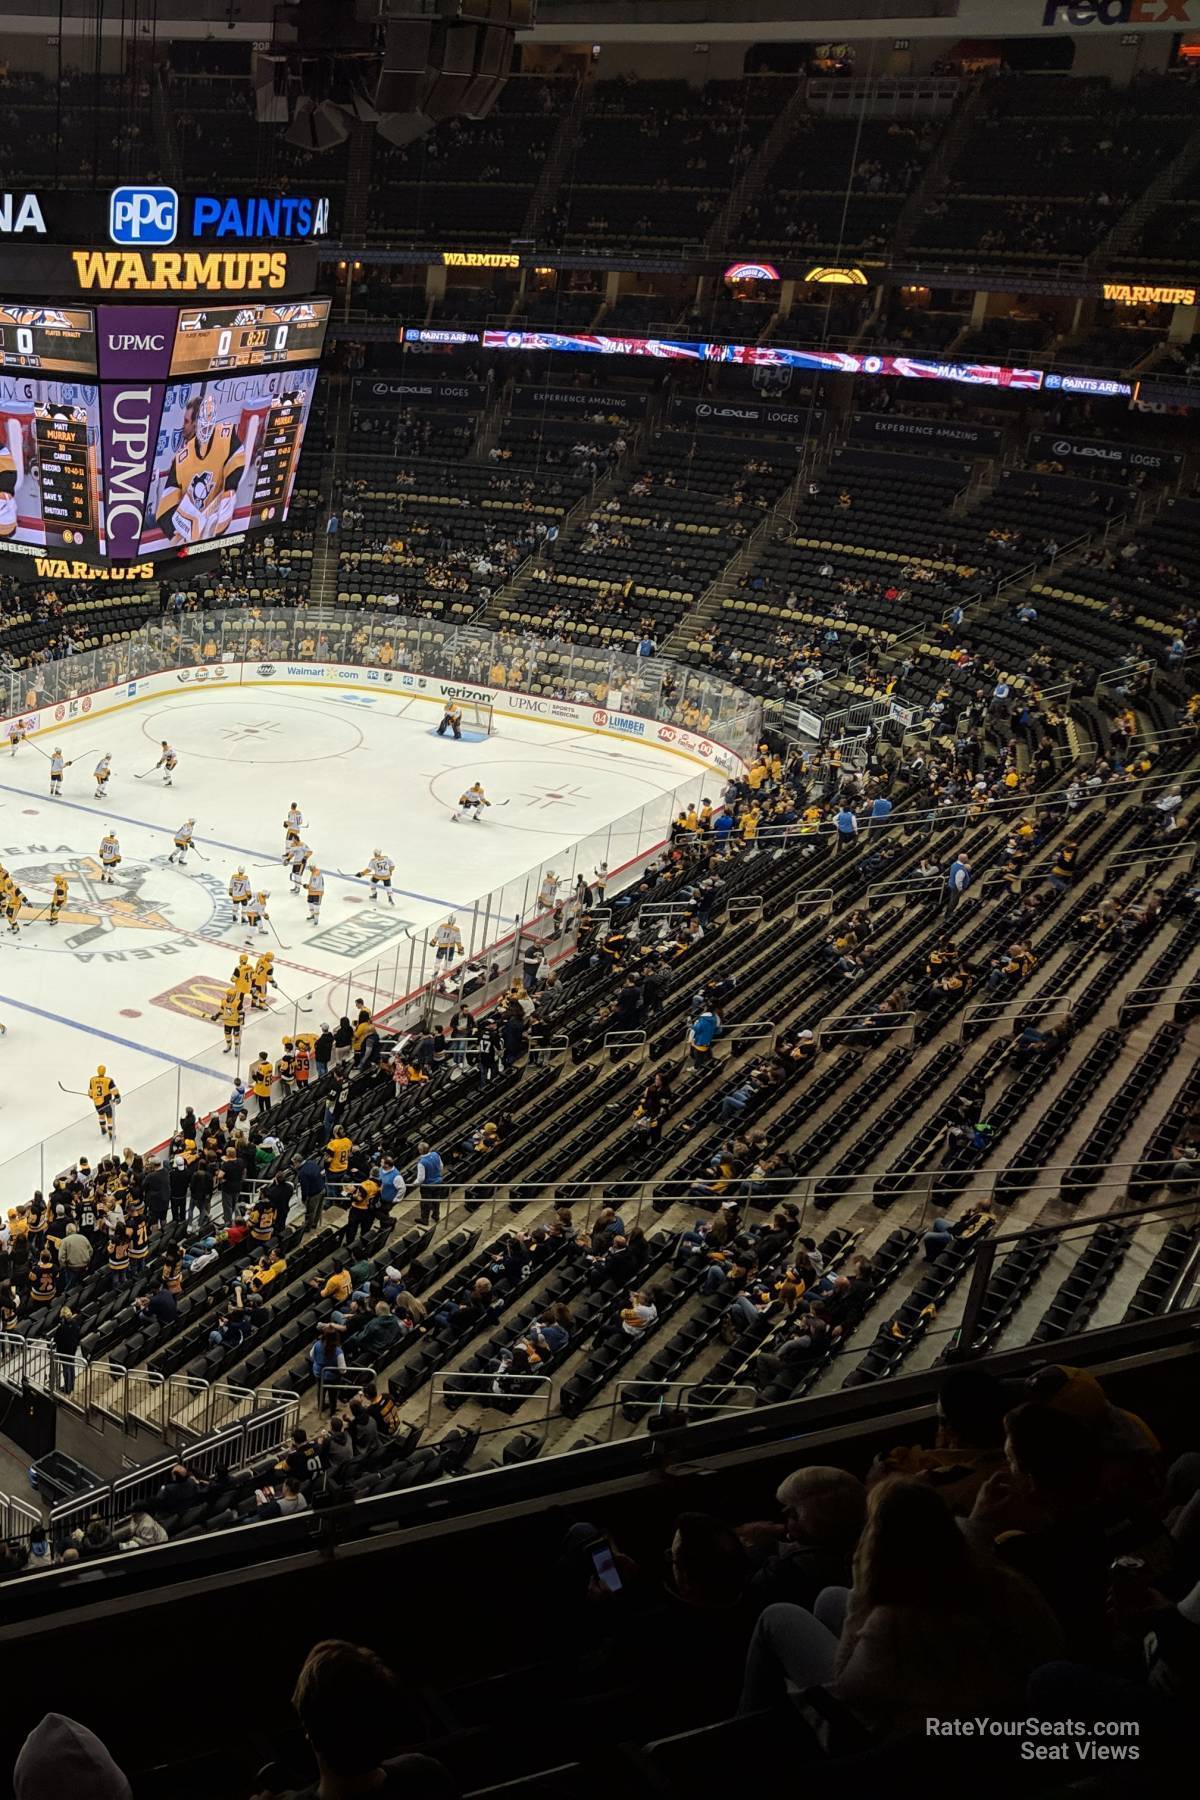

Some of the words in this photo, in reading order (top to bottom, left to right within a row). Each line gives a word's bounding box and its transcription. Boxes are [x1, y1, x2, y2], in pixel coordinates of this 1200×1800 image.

[114, 194, 174, 238] PPG
[192, 198, 312, 237] PAINTS
[442, 253, 520, 268] WARMUPS
[72, 251, 286, 290] WARMUPS
[1103, 284, 1196, 305] WARMUPS
[16, 328, 33, 353] 0
[108, 335, 165, 351] UPMC
[218, 331, 232, 355] 0
[275, 326, 288, 350] 0
[420, 331, 449, 341] PAINTS
[450, 333, 479, 342] ARENA
[390, 386, 432, 395] LEXUS
[440, 387, 469, 398] LOGES
[1062, 378, 1097, 391] PAINTS
[1099, 382, 1131, 394] ARENA
[534, 393, 585, 404] EXPERIENCE
[588, 396, 627, 408] AMAZING
[714, 409, 759, 418] LEXUS
[767, 411, 799, 424] LOGES
[46, 430, 76, 442] MURRAY
[875, 422, 933, 436] EXPERIENCE
[936, 427, 978, 441] AMAZING
[106, 387, 151, 540] UPMC
[1073, 446, 1122, 460] LEXUS
[1130, 454, 1161, 467] LOGES
[287, 666, 324, 677] Walmart
[338, 670, 359, 680] com
[440, 685, 491, 702] verizon
[508, 696, 548, 713] UPMC
[552, 704, 575, 713] SPORTS
[552, 710, 579, 719] MEDICINE
[593, 712, 607, 725] 84
[609, 715, 645, 731] LUMBER
[76, 938, 198, 963] ARENA
[96, 1085, 103, 1097] 3
[81, 1212, 94, 1226] 18
